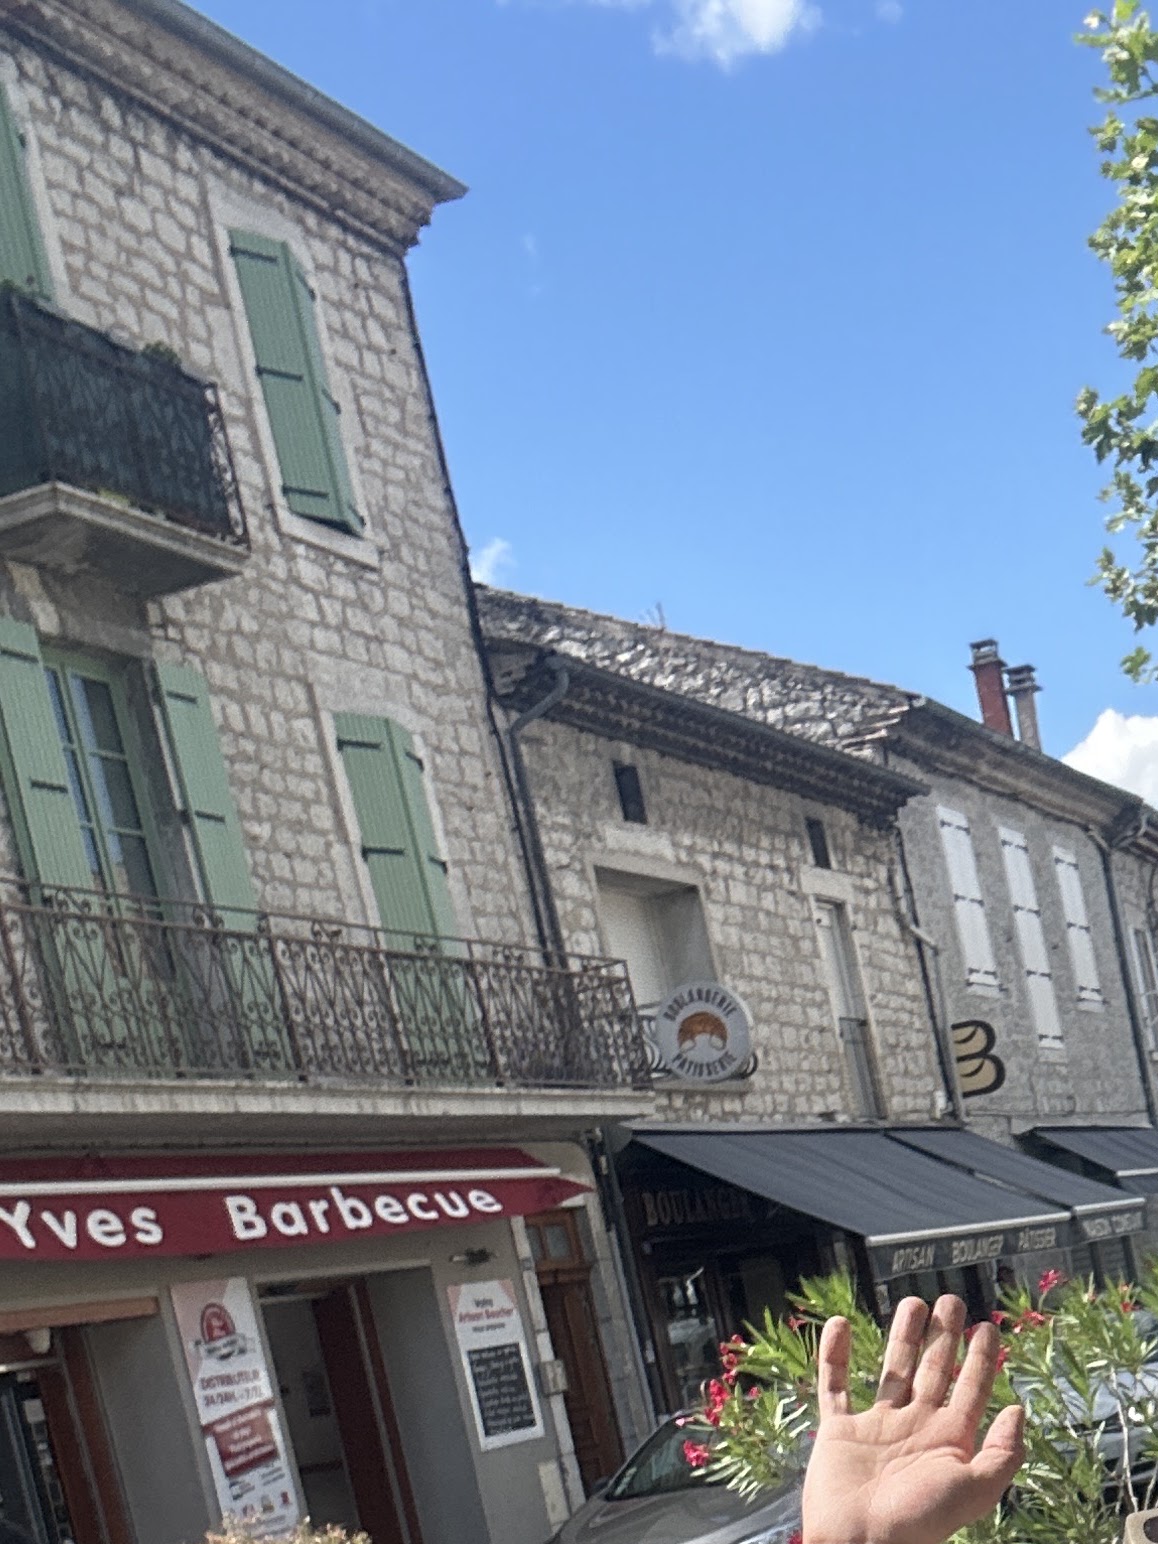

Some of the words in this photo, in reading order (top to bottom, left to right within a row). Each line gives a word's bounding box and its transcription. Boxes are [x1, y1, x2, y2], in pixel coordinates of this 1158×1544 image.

[0, 1199, 164, 1249] Yves
[224, 1186, 503, 1241] Barbecue
[891, 1244, 936, 1273] ARTISAN
[951, 1234, 1004, 1264] BOULANGER
